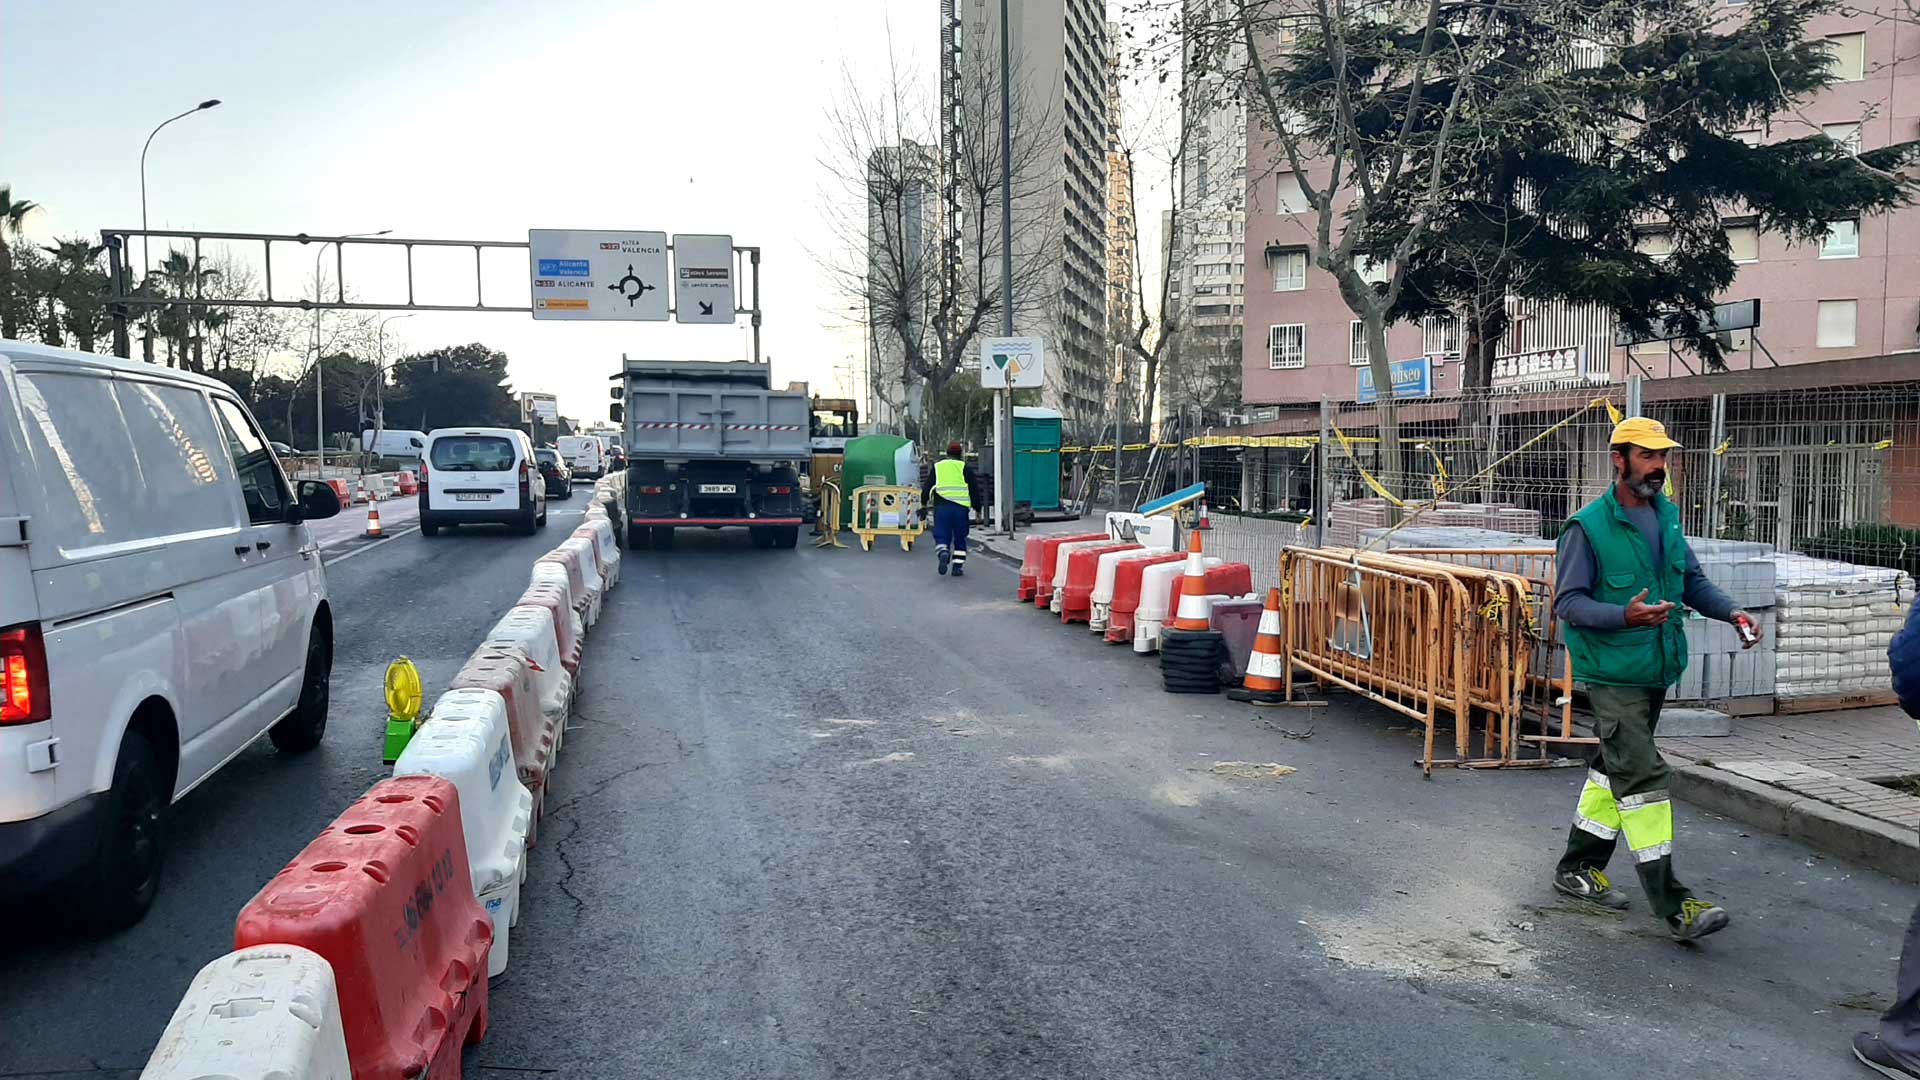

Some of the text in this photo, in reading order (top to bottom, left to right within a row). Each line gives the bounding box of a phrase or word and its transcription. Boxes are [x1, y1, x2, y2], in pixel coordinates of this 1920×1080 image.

[559, 260, 588, 268] Alicante
[559, 268, 588, 276] Valencia
[1390, 365, 1420, 384] oliseo
